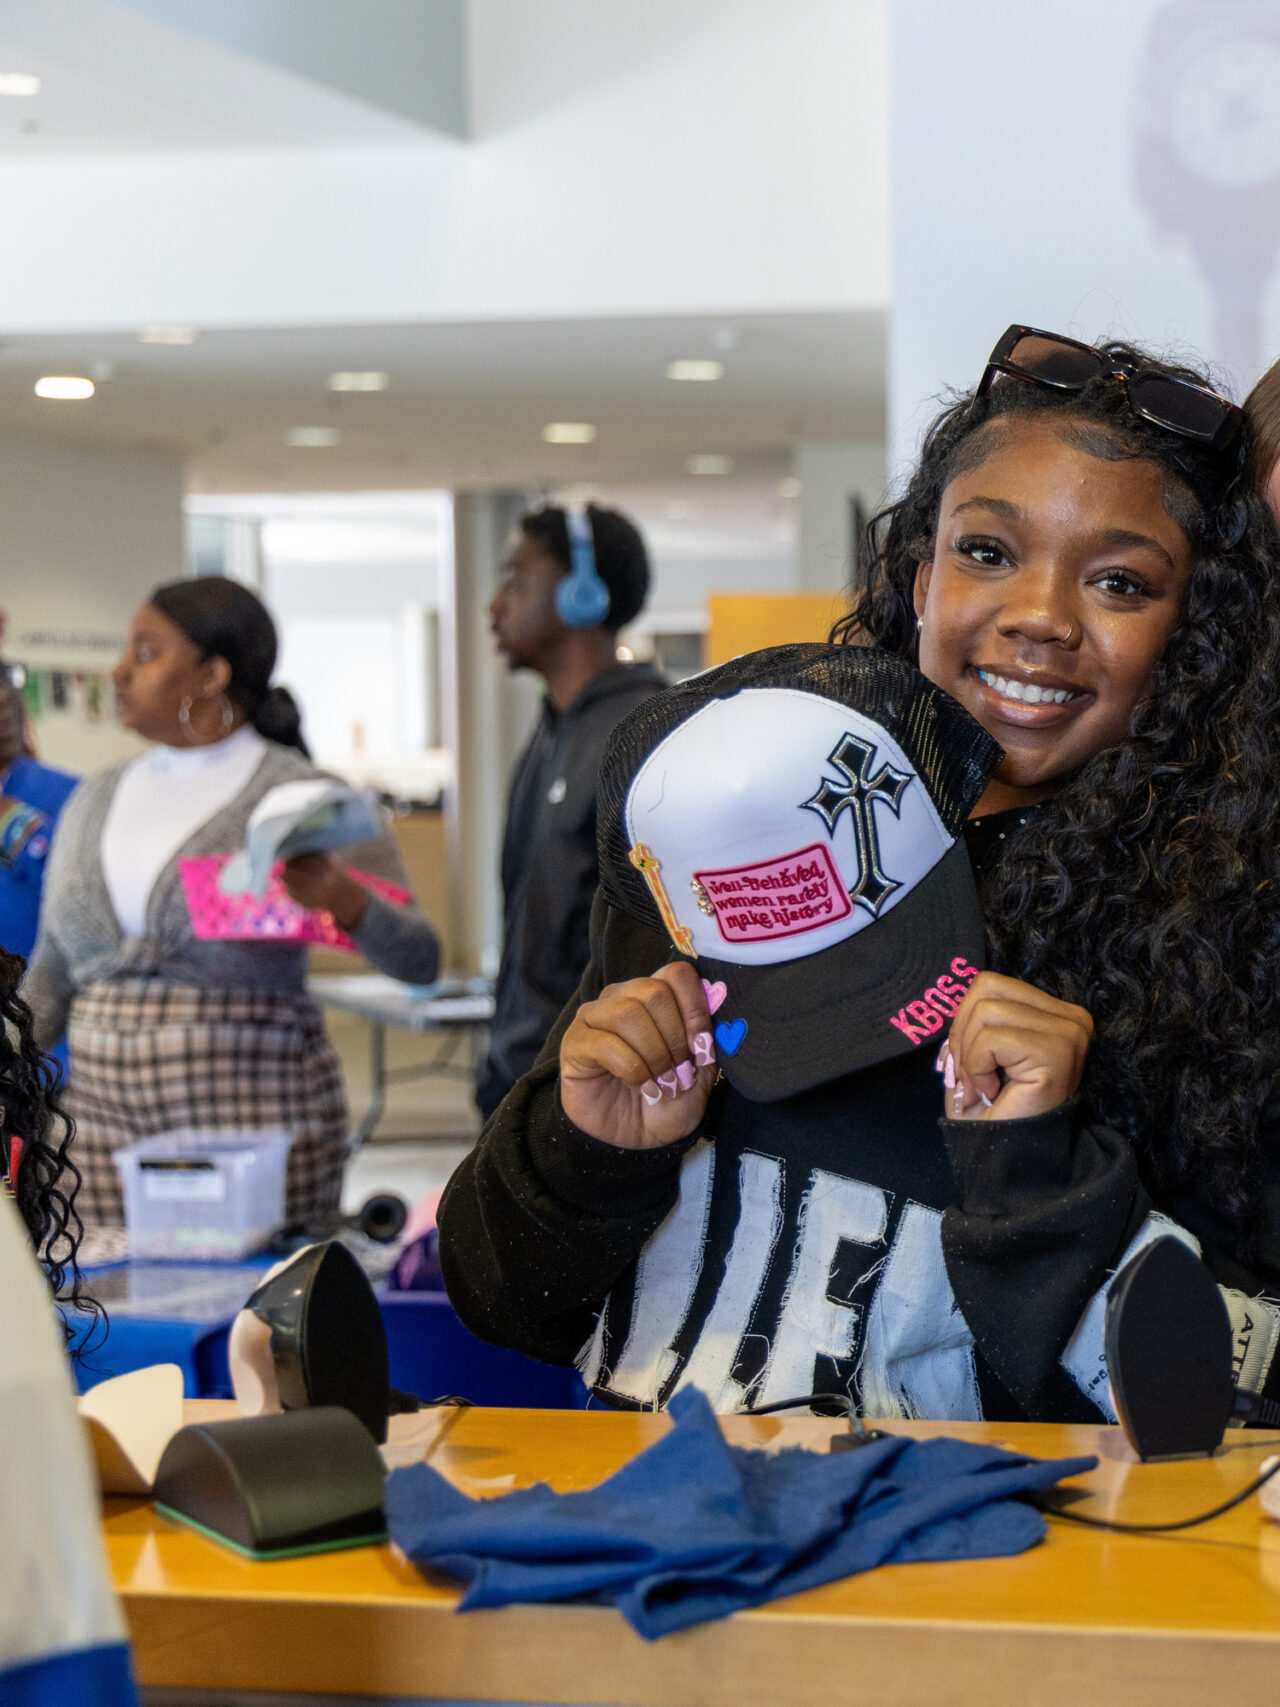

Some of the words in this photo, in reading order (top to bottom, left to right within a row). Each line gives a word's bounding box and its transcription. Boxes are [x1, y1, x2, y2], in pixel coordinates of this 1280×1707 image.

[715, 895, 777, 912] women
[776, 878, 829, 906] rarely
[725, 909, 774, 932] make
[771, 897, 834, 927] history
[889, 957, 980, 1046] KBOSS
